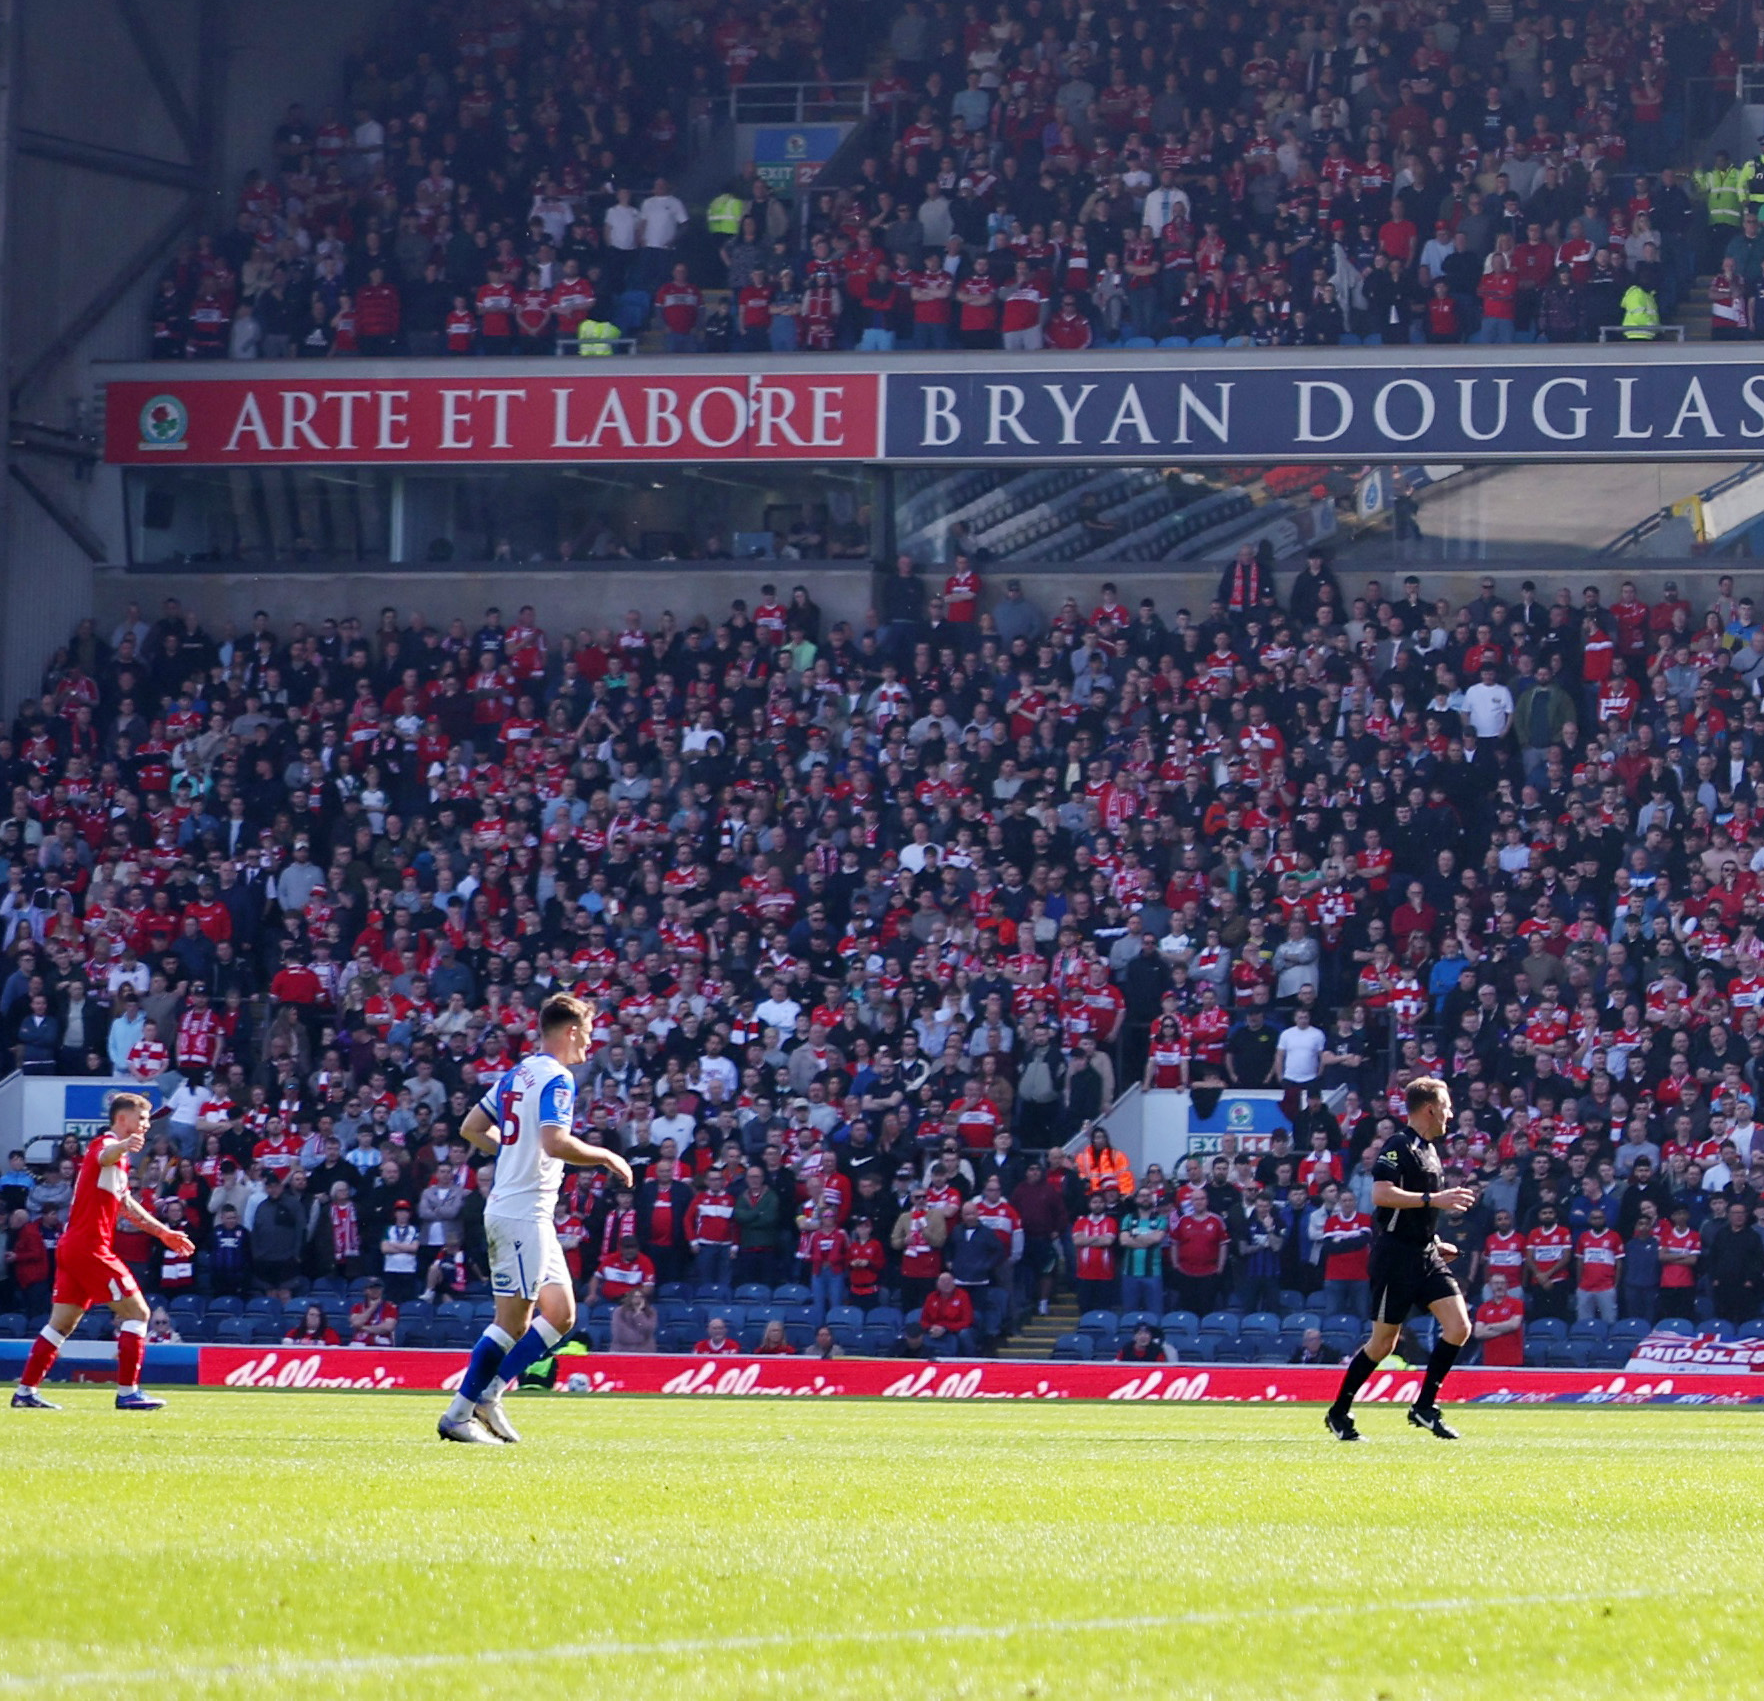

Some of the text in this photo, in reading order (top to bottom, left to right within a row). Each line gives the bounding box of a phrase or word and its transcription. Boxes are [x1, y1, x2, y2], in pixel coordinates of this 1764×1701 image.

[222, 390, 410, 451] ARTE
[439, 389, 526, 449] ET
[551, 385, 845, 448] LABORE
[920, 382, 1235, 446] BRYAN
